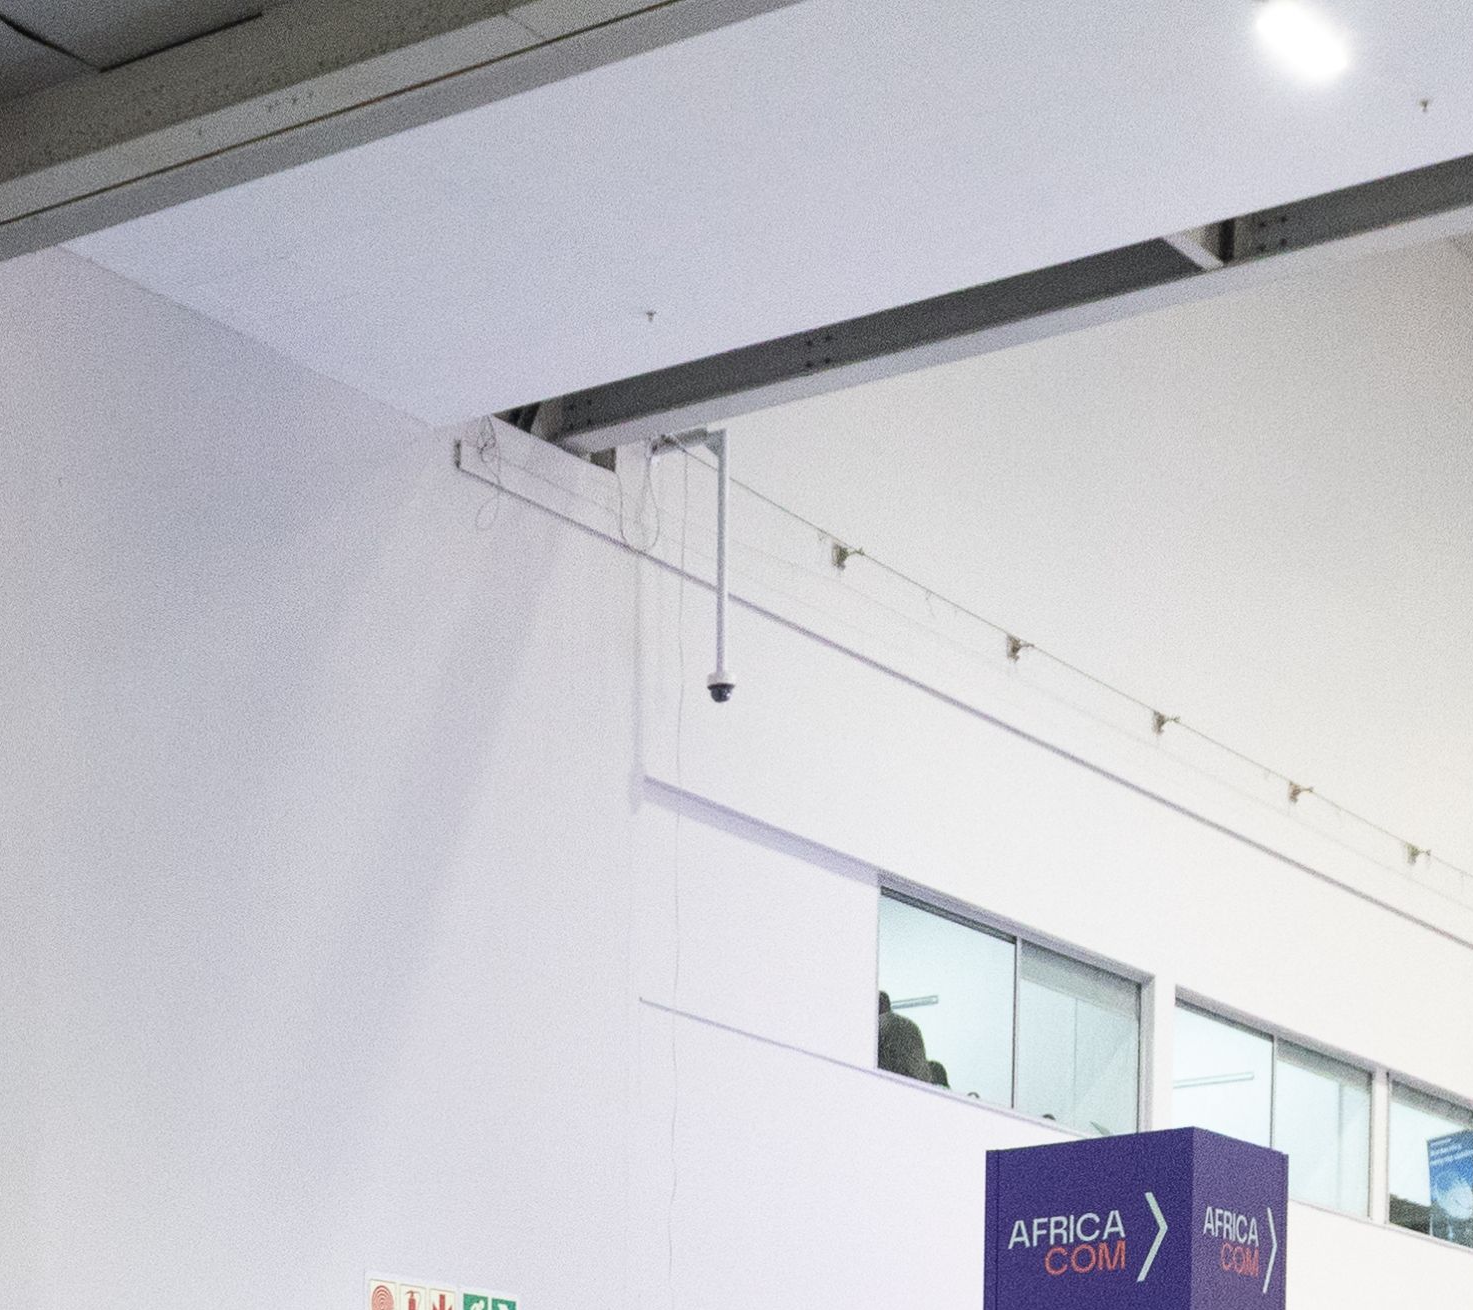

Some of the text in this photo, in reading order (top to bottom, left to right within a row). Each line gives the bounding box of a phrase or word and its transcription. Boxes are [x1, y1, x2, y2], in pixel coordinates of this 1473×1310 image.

[1008, 1210, 1126, 1250] AFRICA
[1203, 1207, 1259, 1248] AFRICA
[1044, 1240, 1126, 1276] COM
[1221, 1243, 1259, 1277] COM
